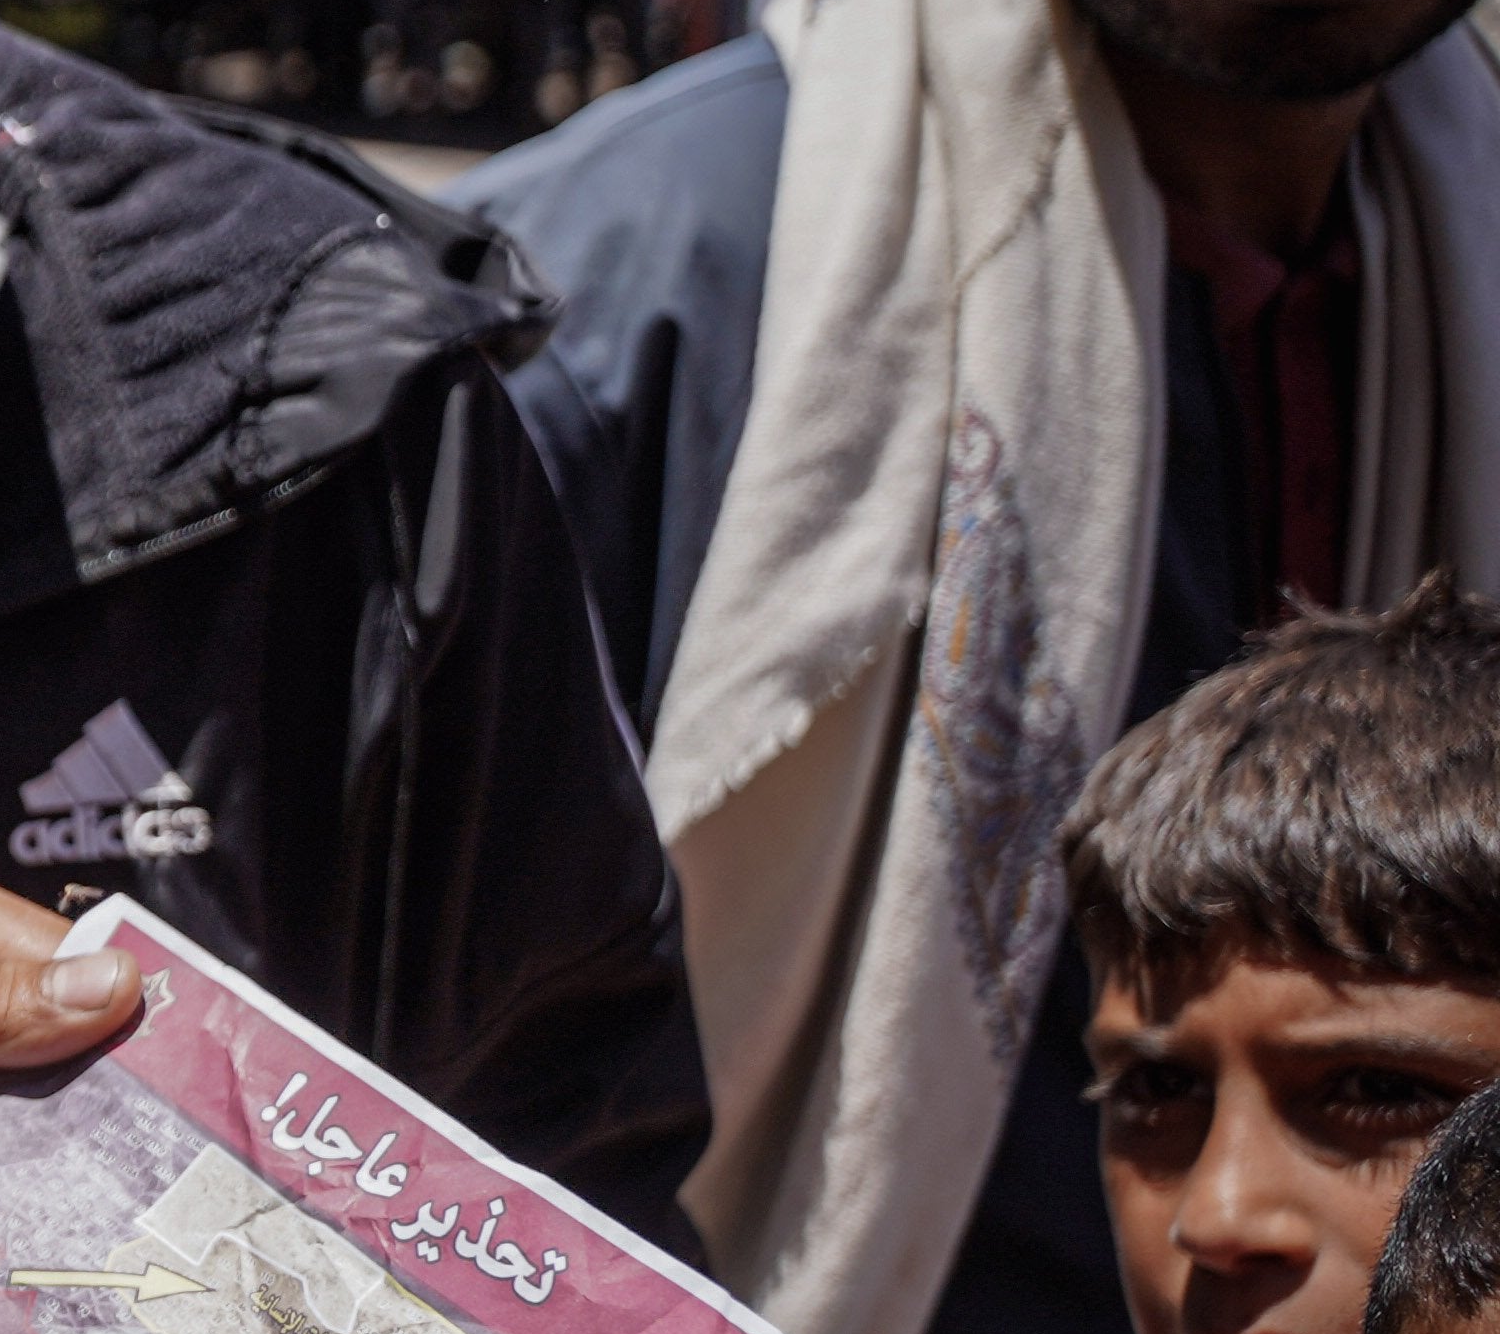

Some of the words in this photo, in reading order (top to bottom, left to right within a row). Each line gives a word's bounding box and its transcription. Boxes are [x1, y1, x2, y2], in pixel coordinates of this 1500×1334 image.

[261, 1072, 408, 1198] عاجل!
[390, 1196, 568, 1305] تحذير
[250, 1283, 306, 1334] الإنسانية
